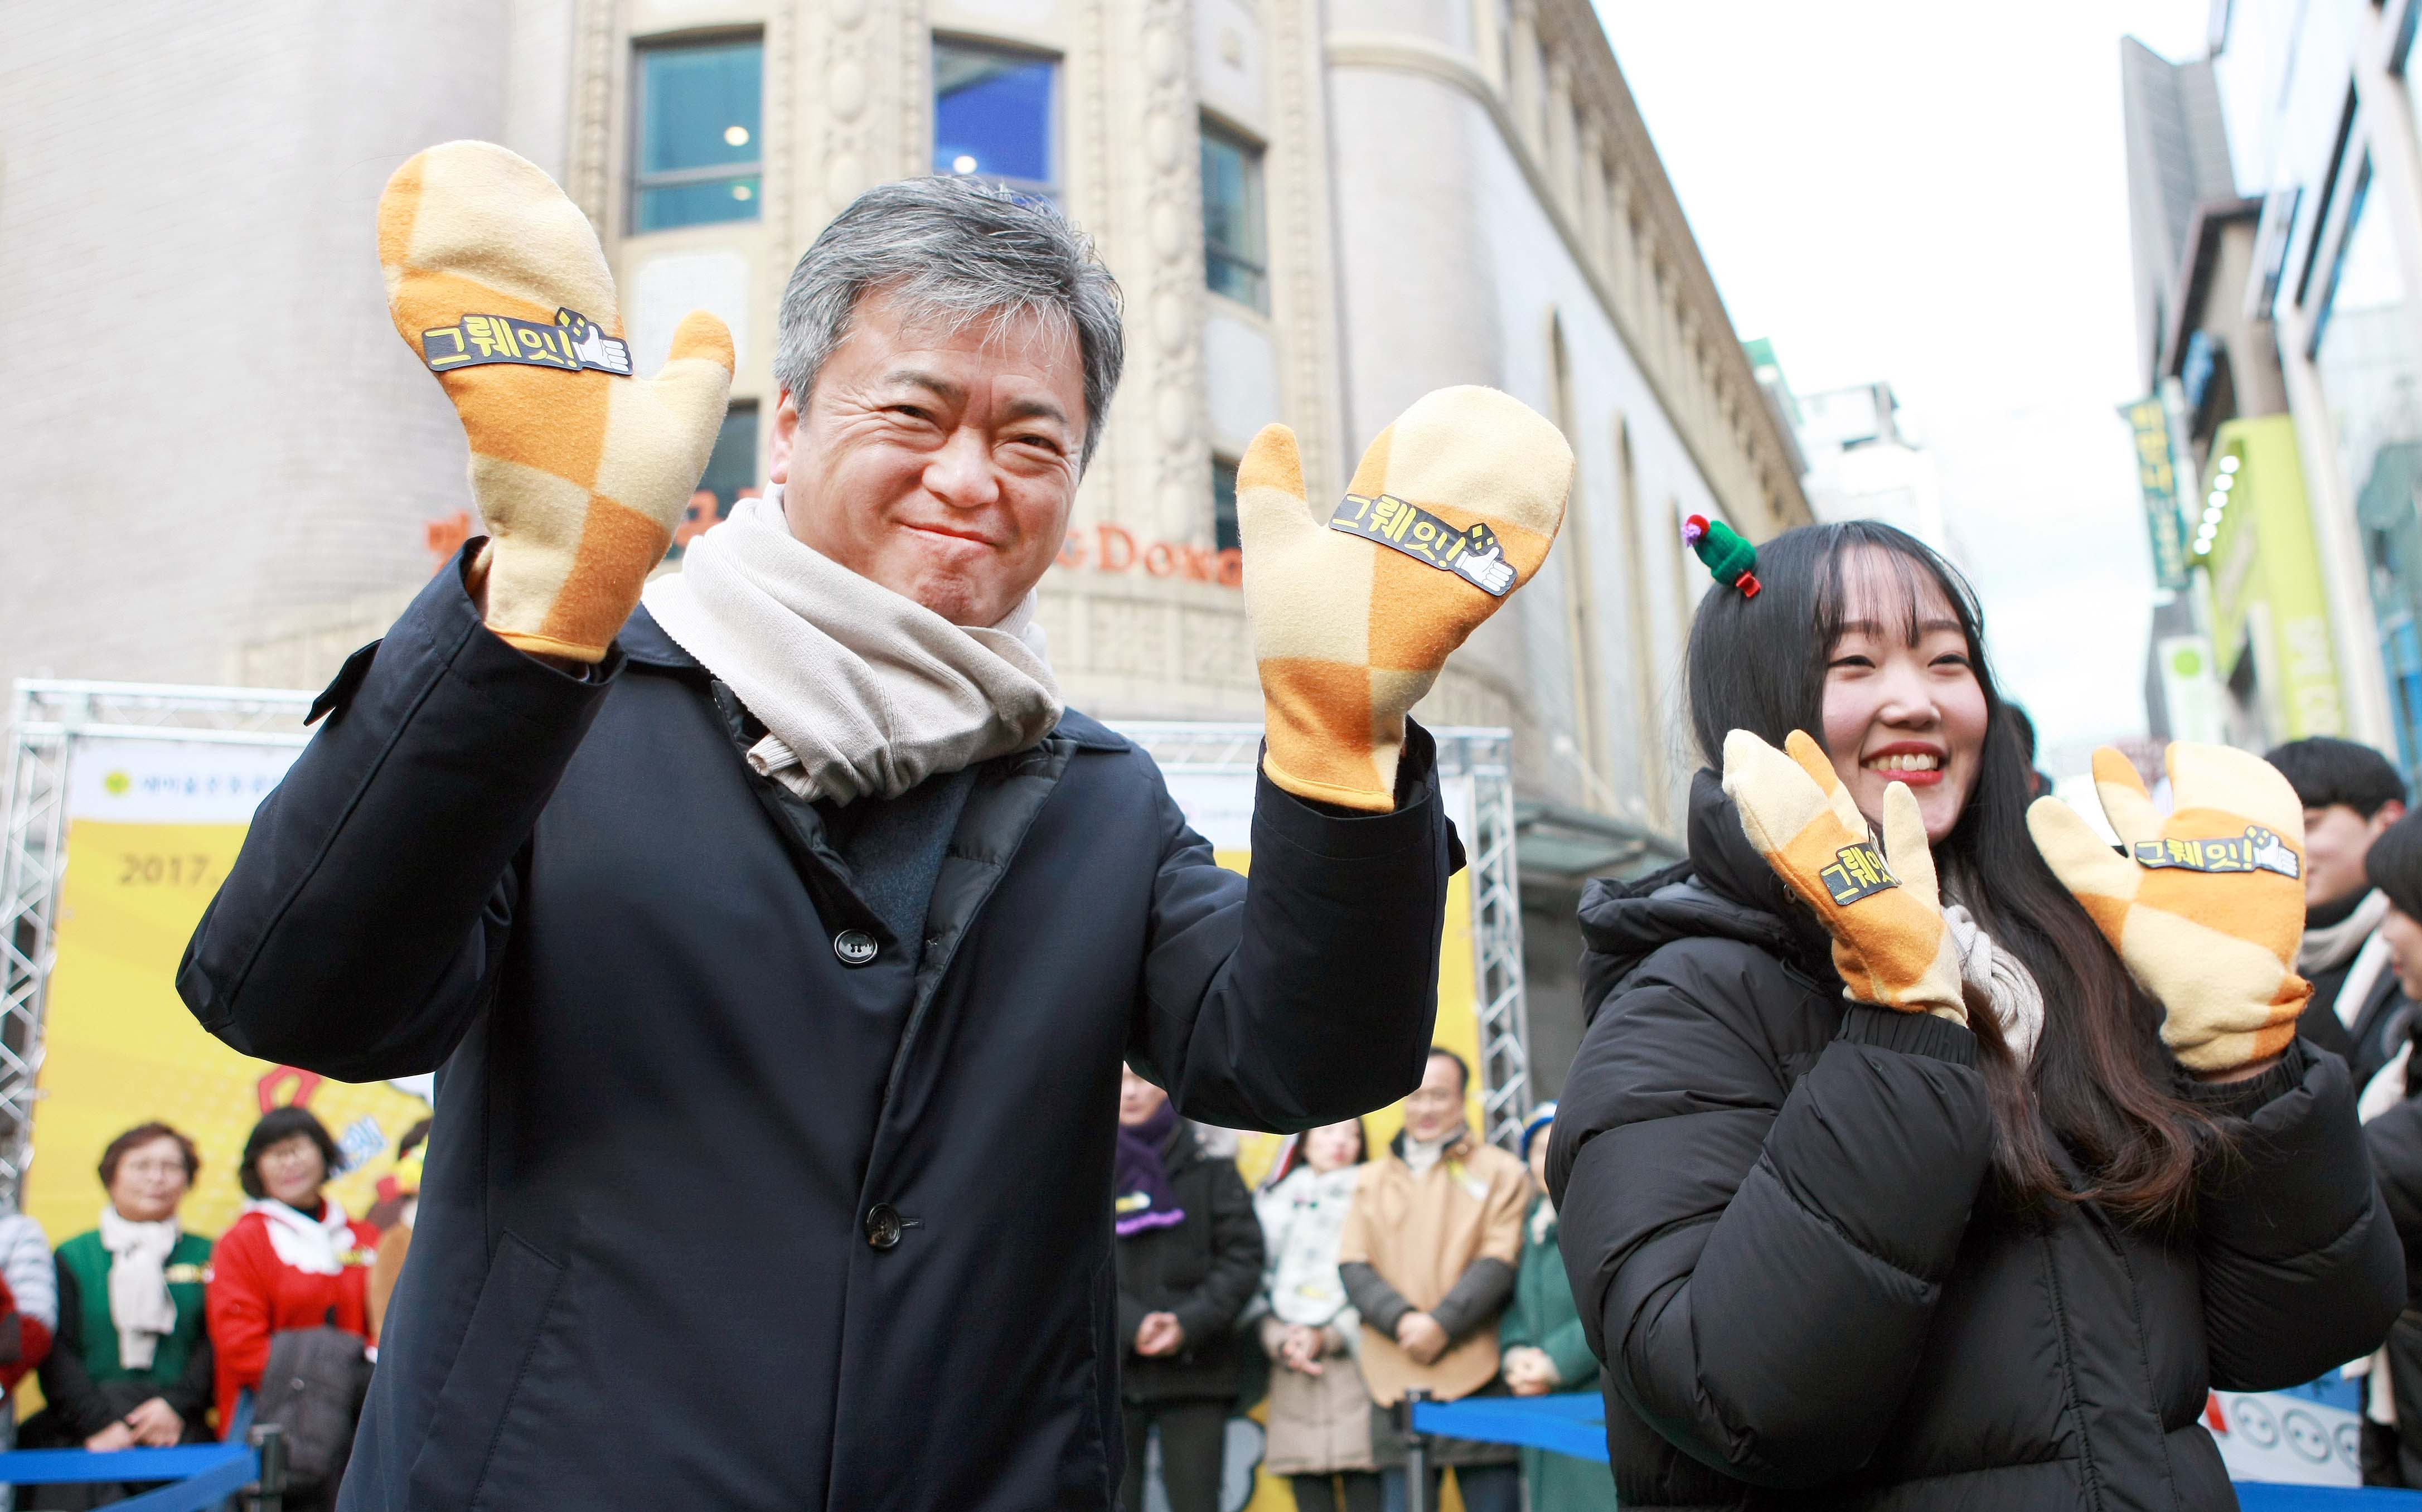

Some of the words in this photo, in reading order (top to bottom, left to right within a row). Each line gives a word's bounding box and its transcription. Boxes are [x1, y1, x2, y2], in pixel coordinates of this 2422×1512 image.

[425, 317, 578, 368] 그뤠잇!
[1332, 495, 1466, 568] 그뤠잇!
[2136, 837, 2253, 870] 그뤠잇!
